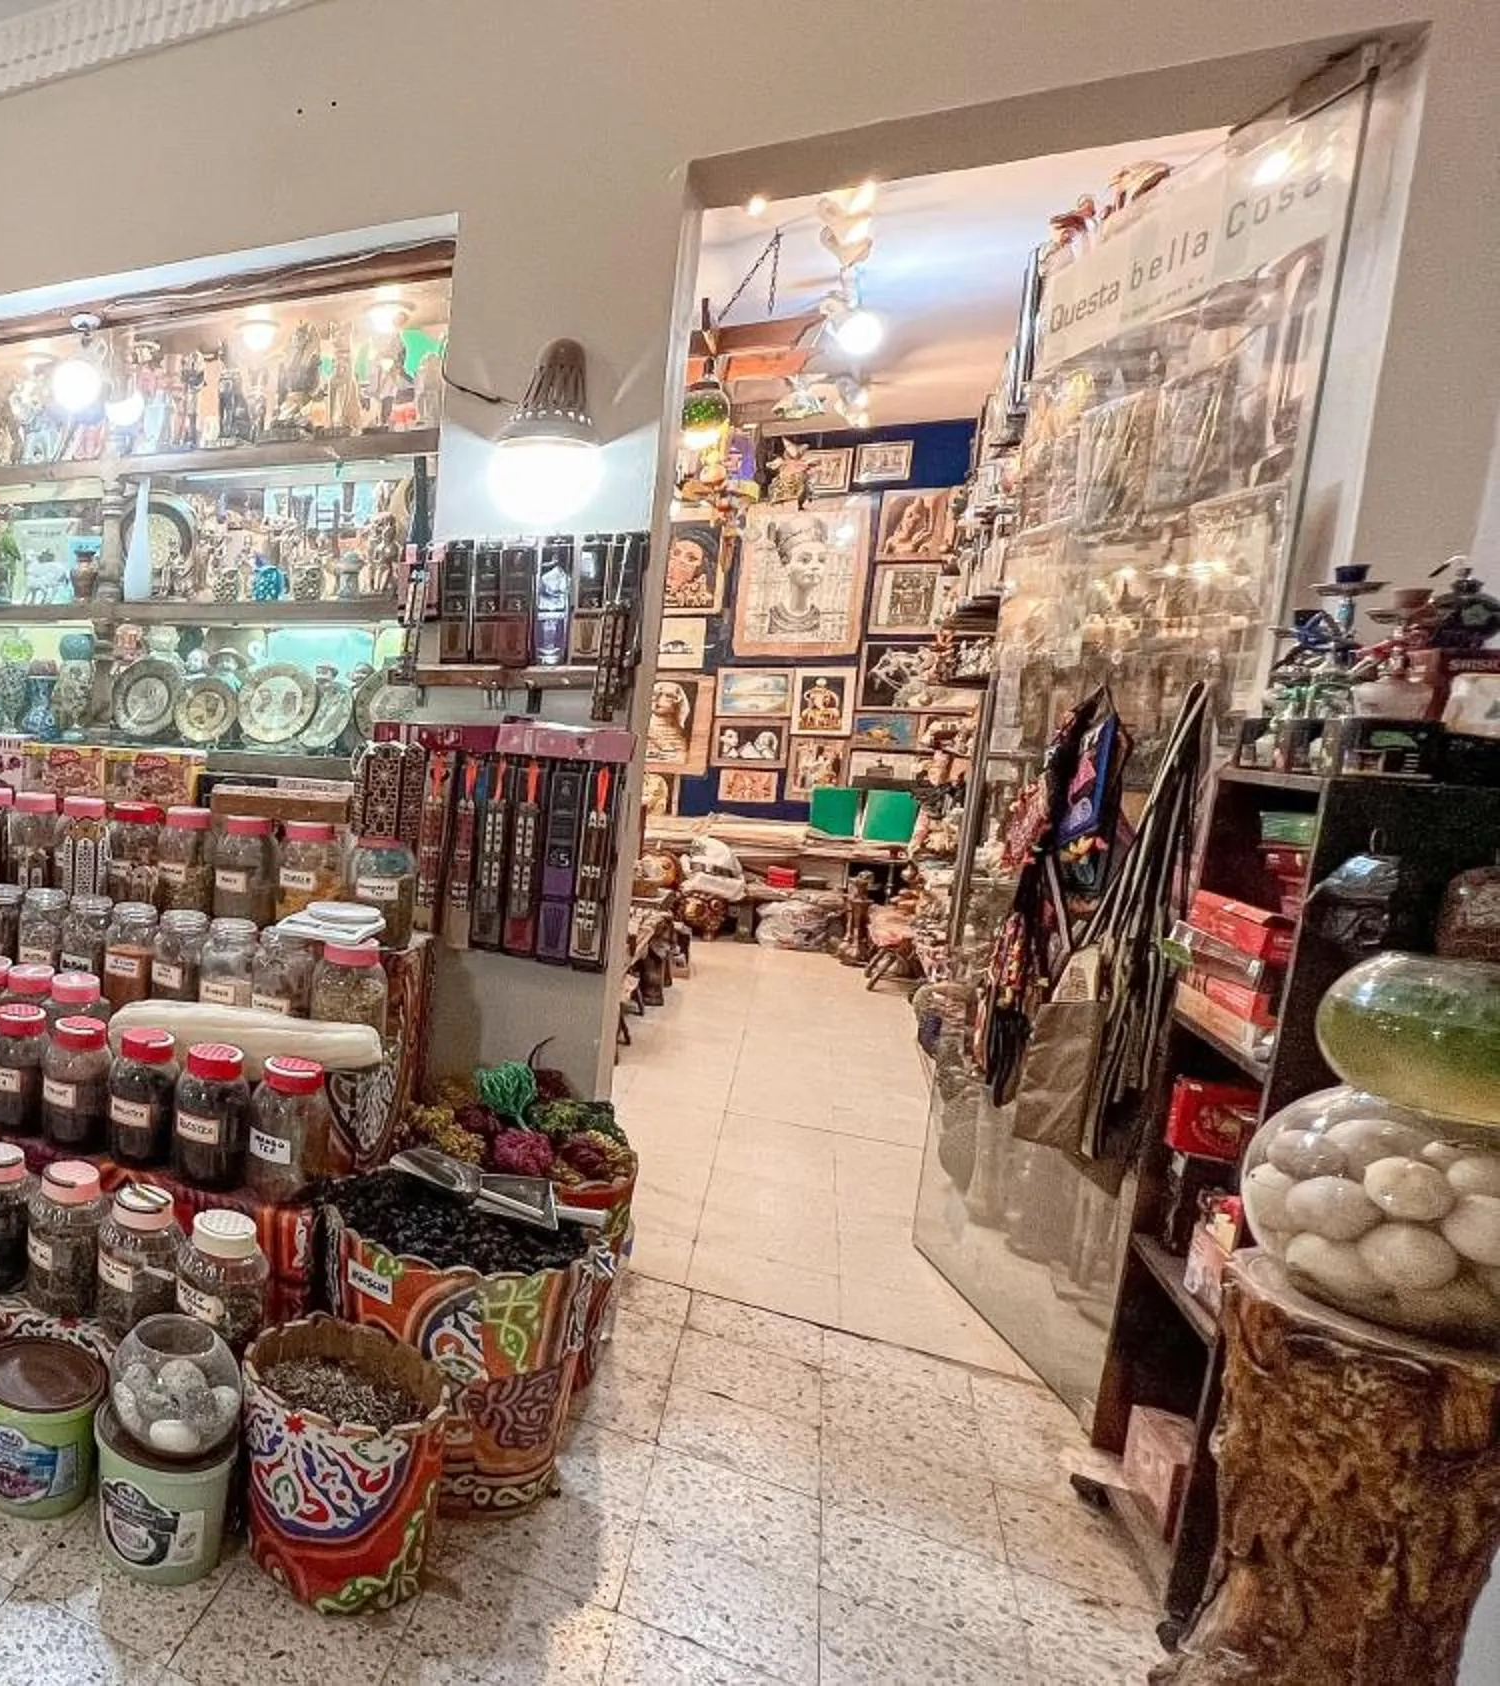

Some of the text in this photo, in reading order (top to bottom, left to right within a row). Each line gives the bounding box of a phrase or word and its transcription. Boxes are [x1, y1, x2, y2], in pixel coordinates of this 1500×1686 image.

[1050, 280, 1120, 334] Questa
[1129, 229, 1209, 291] bella
[1225, 173, 1324, 241] Cosa
